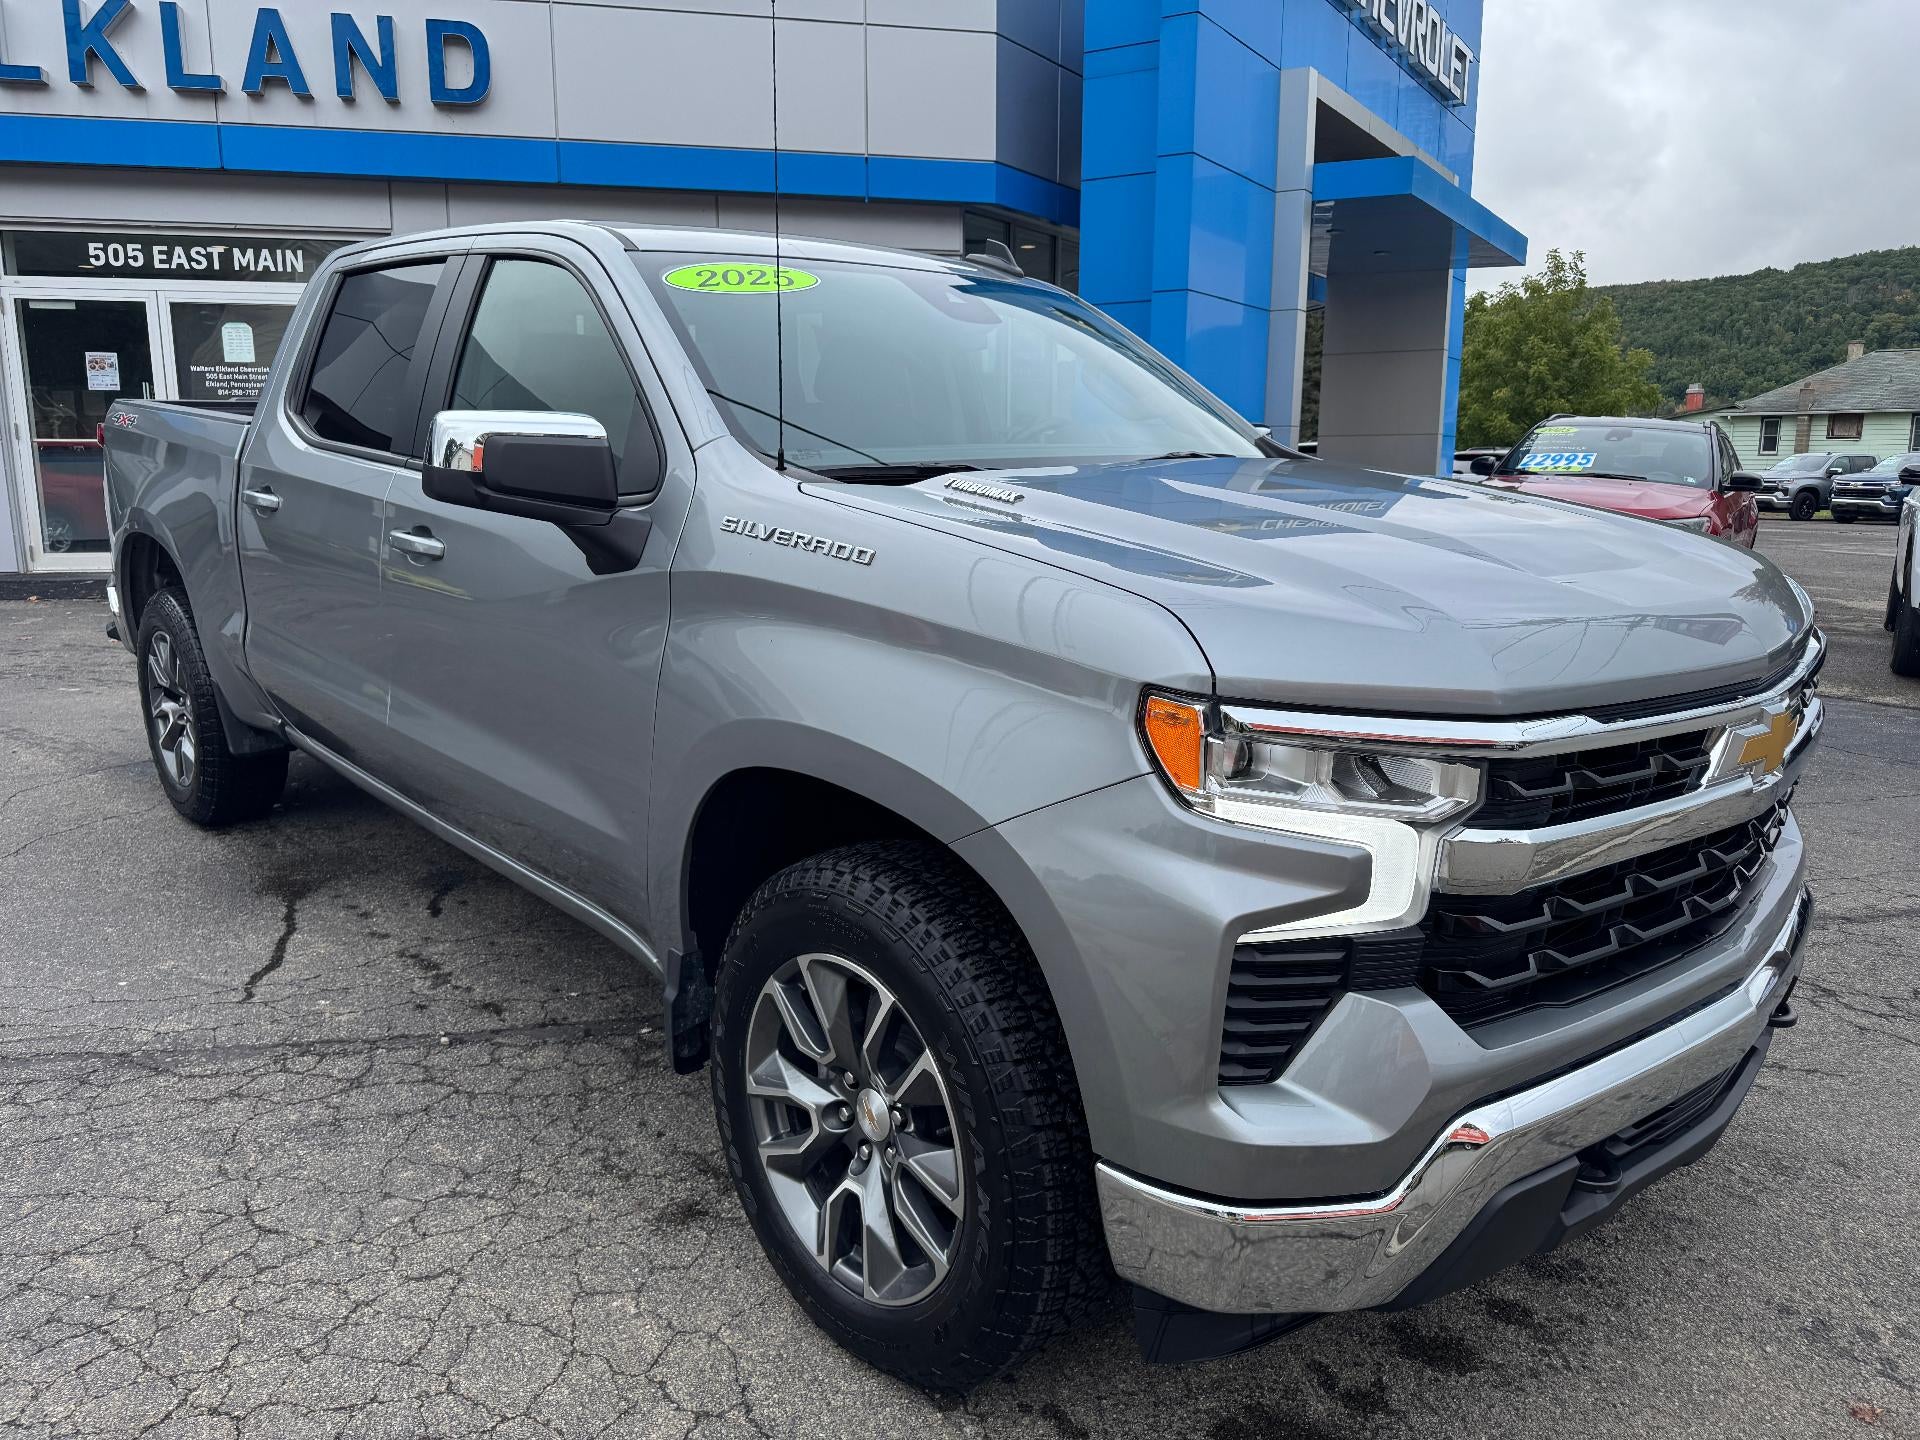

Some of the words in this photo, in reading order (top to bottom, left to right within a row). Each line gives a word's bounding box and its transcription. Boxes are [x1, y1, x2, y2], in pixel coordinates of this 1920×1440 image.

[88, 243, 144, 267] 505
[153, 245, 225, 270] EAST
[233, 248, 304, 272] MAIN
[695, 269, 795, 288] 2025
[1520, 454, 1594, 467] 22995
[944, 477, 1024, 503] TURBOMAX
[720, 516, 876, 566] SILVERADO
